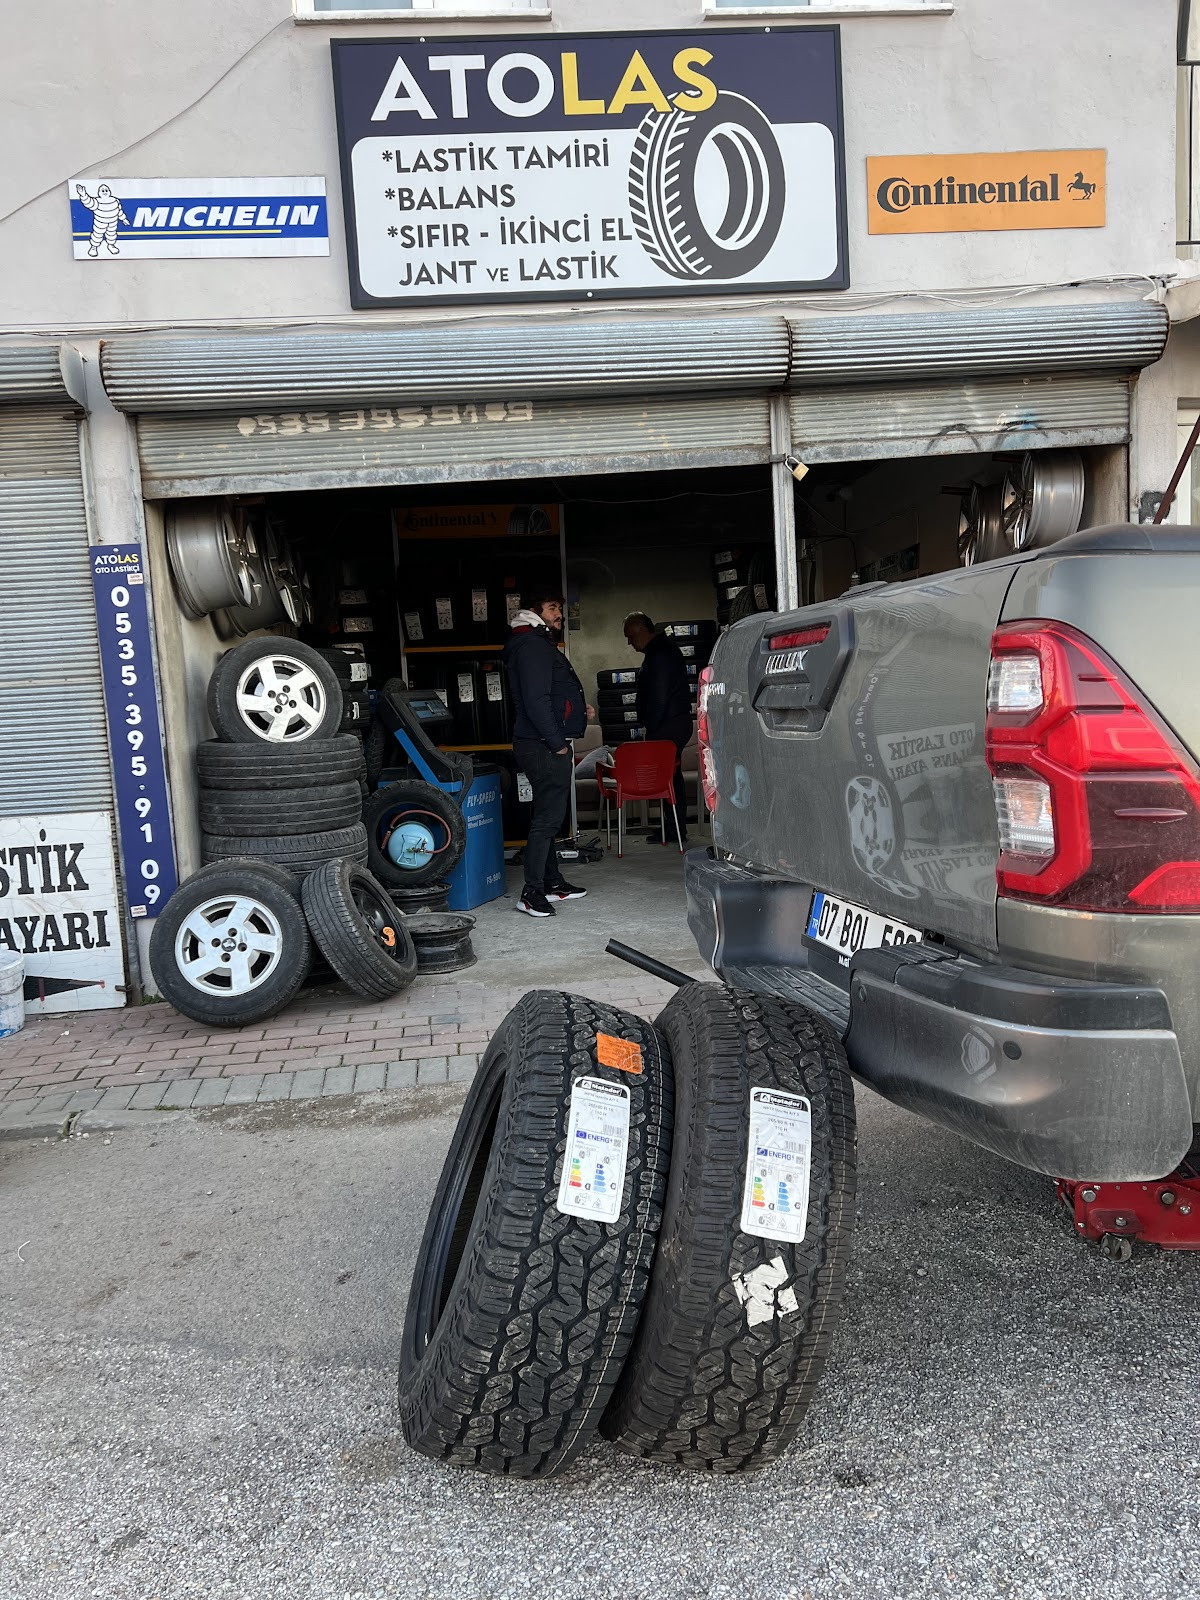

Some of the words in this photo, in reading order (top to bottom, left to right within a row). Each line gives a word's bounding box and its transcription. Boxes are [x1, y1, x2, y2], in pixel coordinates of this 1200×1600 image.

[371, 47, 718, 121] ATOLAS
[506, 137, 610, 170] TAMİRİ
[876, 172, 1060, 214] Continental
[132, 204, 320, 228] MICHELIN
[500, 213, 590, 245] İKİNCİ
[601, 217, 633, 242] EL
[399, 259, 478, 287] JANT
[519, 250, 620, 282] LASTİK
[94, 553, 139, 566] ATOLAS
[94, 566, 110, 574] OTO
[818, 899, 840, 940] 07
[770, 1096, 801, 1108] Matador
